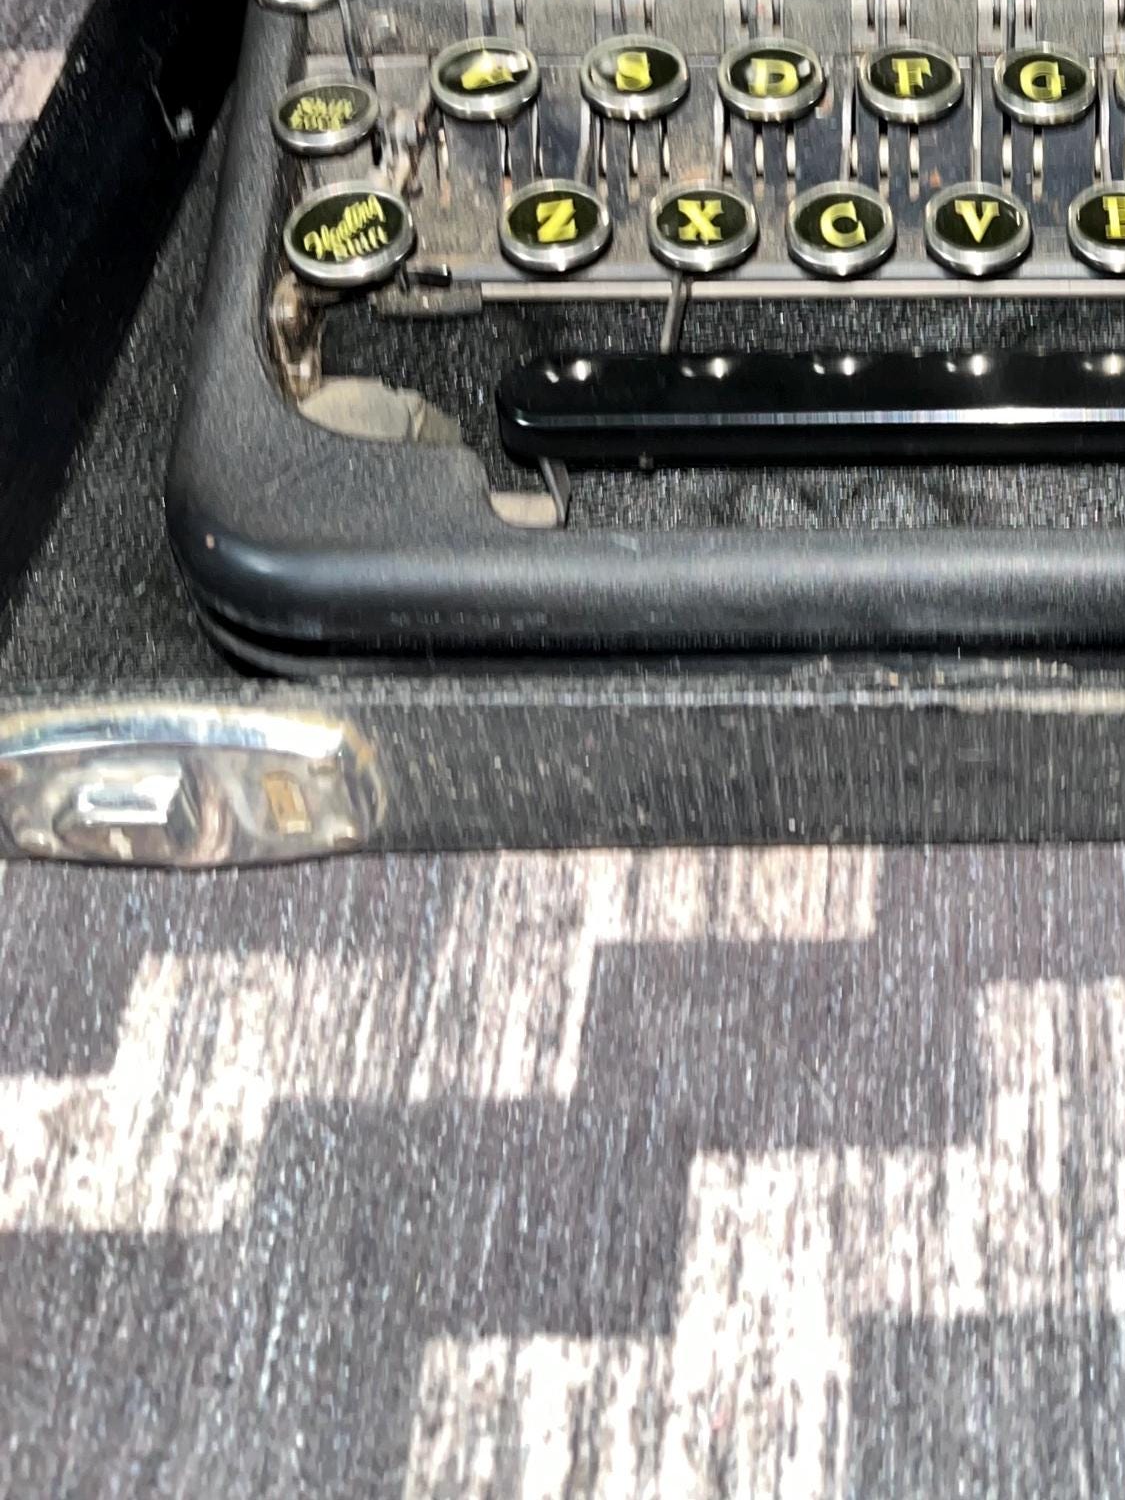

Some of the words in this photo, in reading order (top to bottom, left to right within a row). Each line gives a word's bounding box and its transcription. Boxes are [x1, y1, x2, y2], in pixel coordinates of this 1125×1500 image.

[750, 58, 800, 98] D
[891, 57, 932, 99] F
[535, 197, 578, 244] Z
[677, 198, 722, 243] X
[819, 200, 866, 248] C
[954, 199, 999, 243] V
